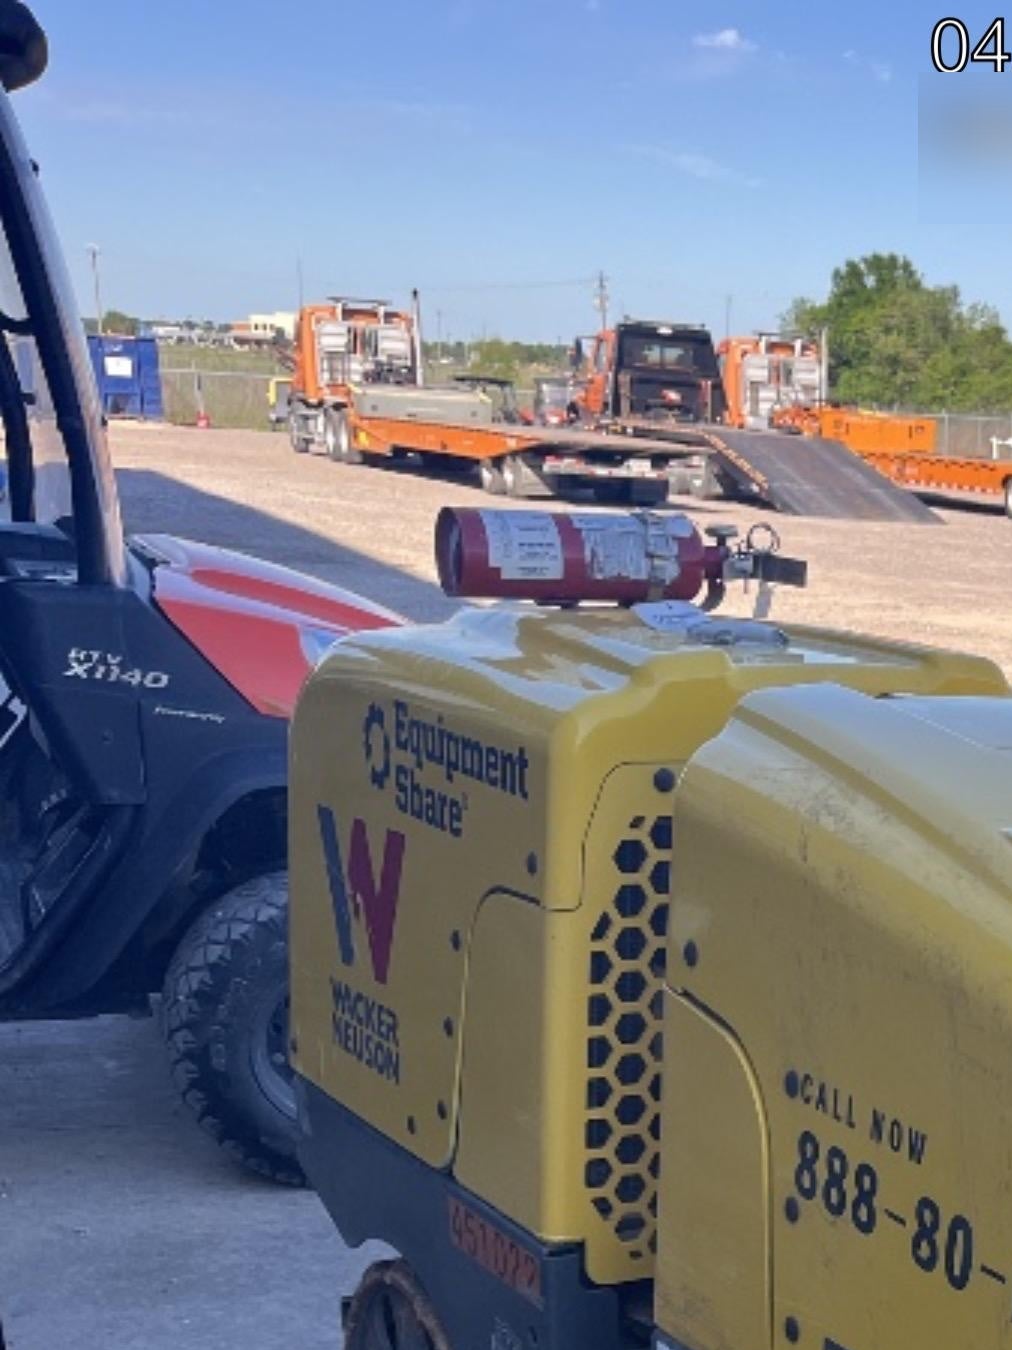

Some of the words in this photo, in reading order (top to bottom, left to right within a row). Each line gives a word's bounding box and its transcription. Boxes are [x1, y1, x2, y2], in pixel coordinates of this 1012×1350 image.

[63, 662, 169, 687] X1140
[395, 698, 529, 801] Equipment
[395, 765, 462, 838] Share
[329, 975, 399, 1048] WACKER
[331, 1009, 400, 1085] NEUSON
[800, 1073, 857, 1129] CALL
[870, 1108, 928, 1165] NOW
